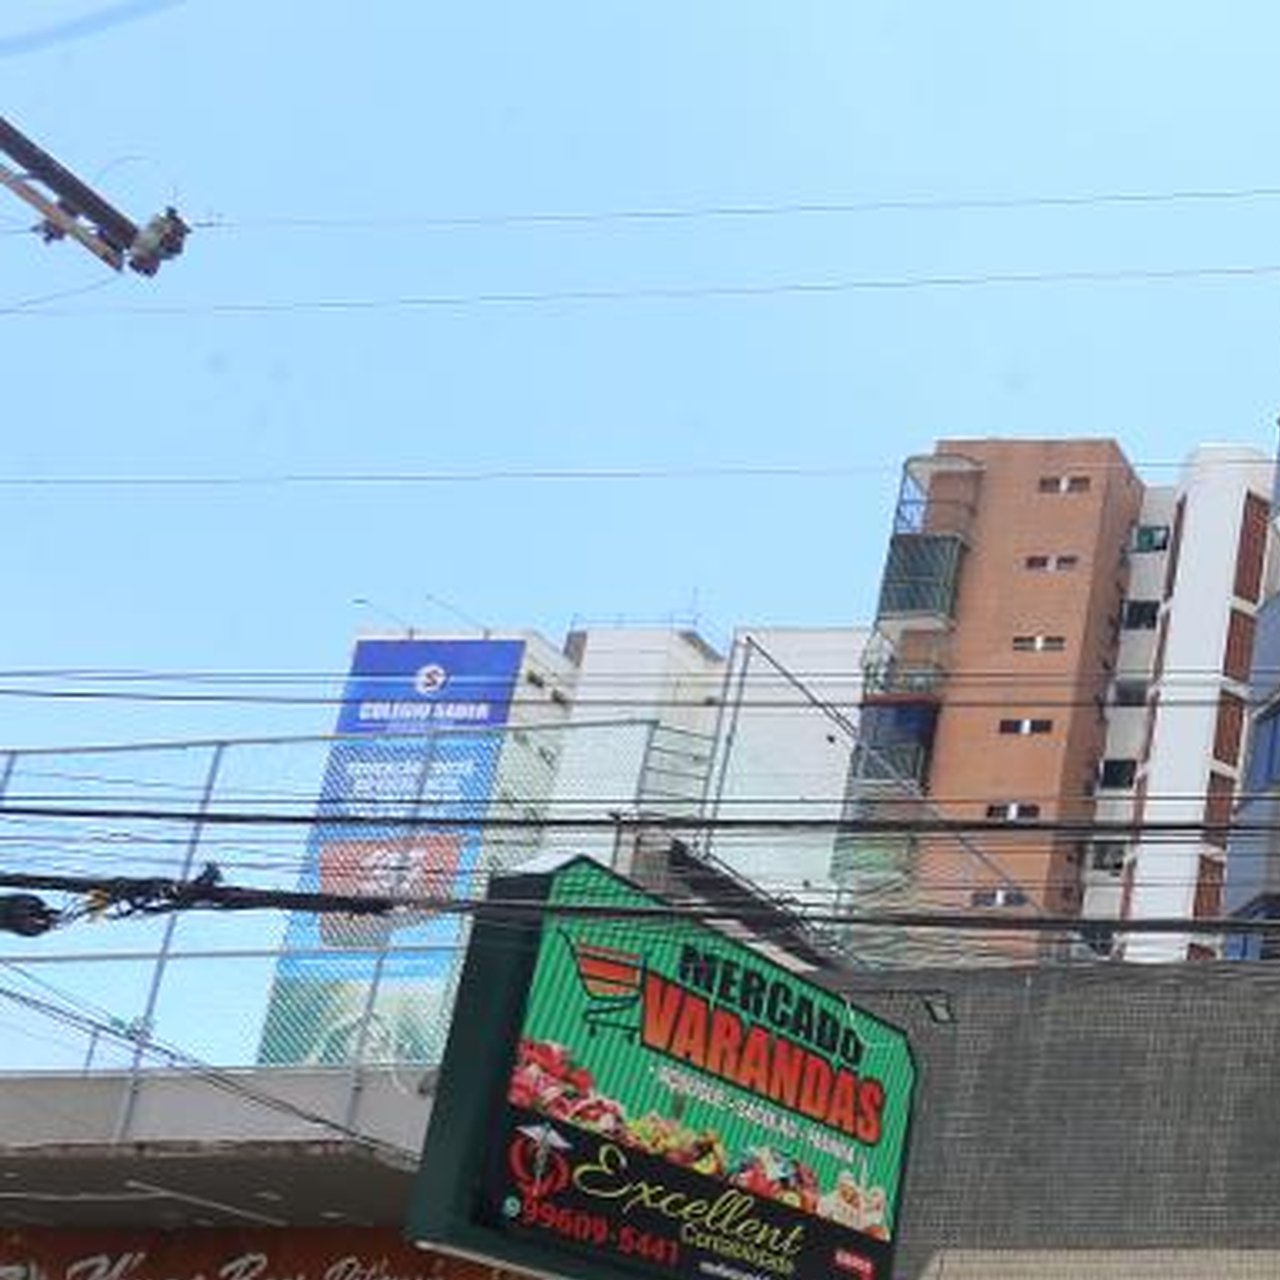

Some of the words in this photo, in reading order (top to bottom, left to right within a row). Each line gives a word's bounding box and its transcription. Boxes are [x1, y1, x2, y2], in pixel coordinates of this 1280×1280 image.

[641, 970, 886, 1147] VARANDAS
[678, 944, 863, 1065] MERCADO
[573, 1145, 804, 1254] Excellent
